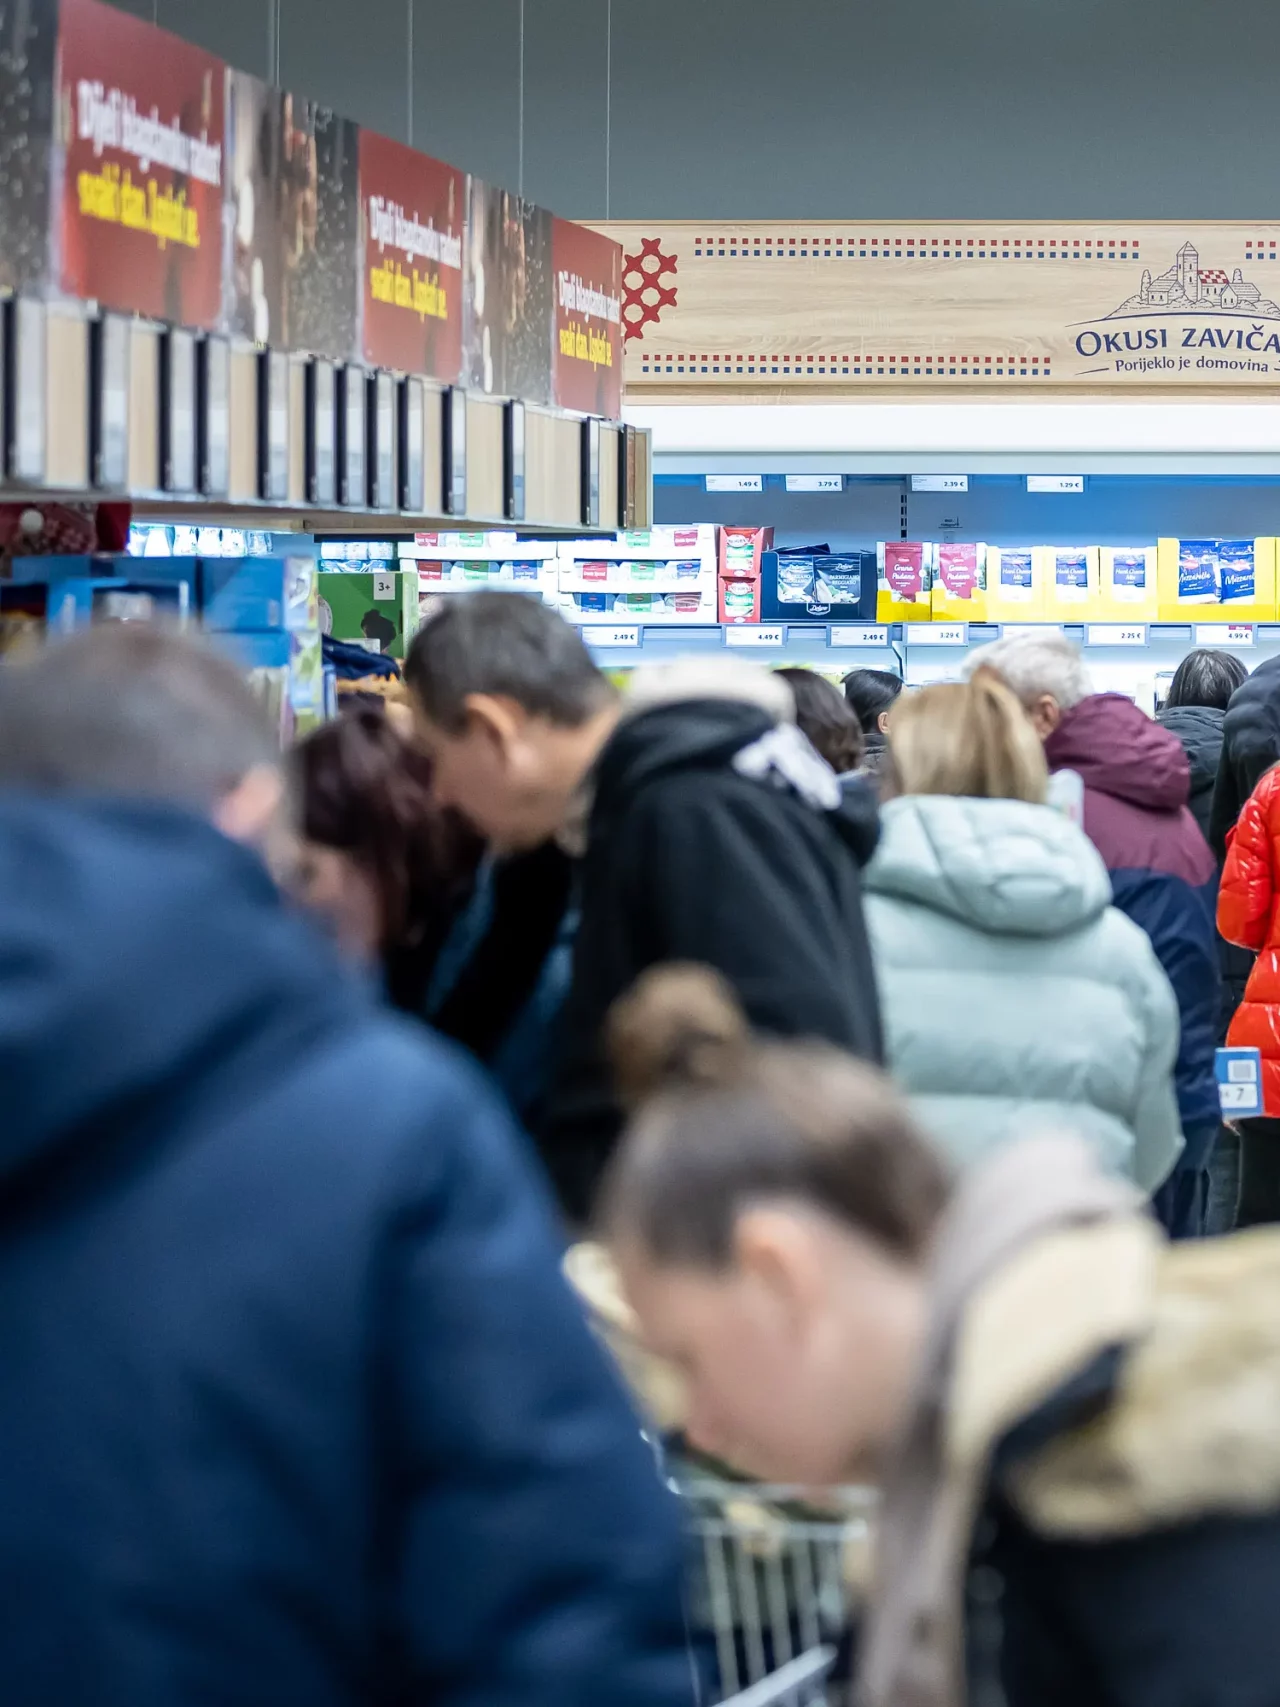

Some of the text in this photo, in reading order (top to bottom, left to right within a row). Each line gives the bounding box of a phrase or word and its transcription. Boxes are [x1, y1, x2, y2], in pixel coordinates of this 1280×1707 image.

[1075, 328, 1167, 357] OKUSI
[1115, 356, 1268, 373] Porijeklo je domovina
[894, 564, 914, 572] Grana
[378, 582, 391, 592] 3+
